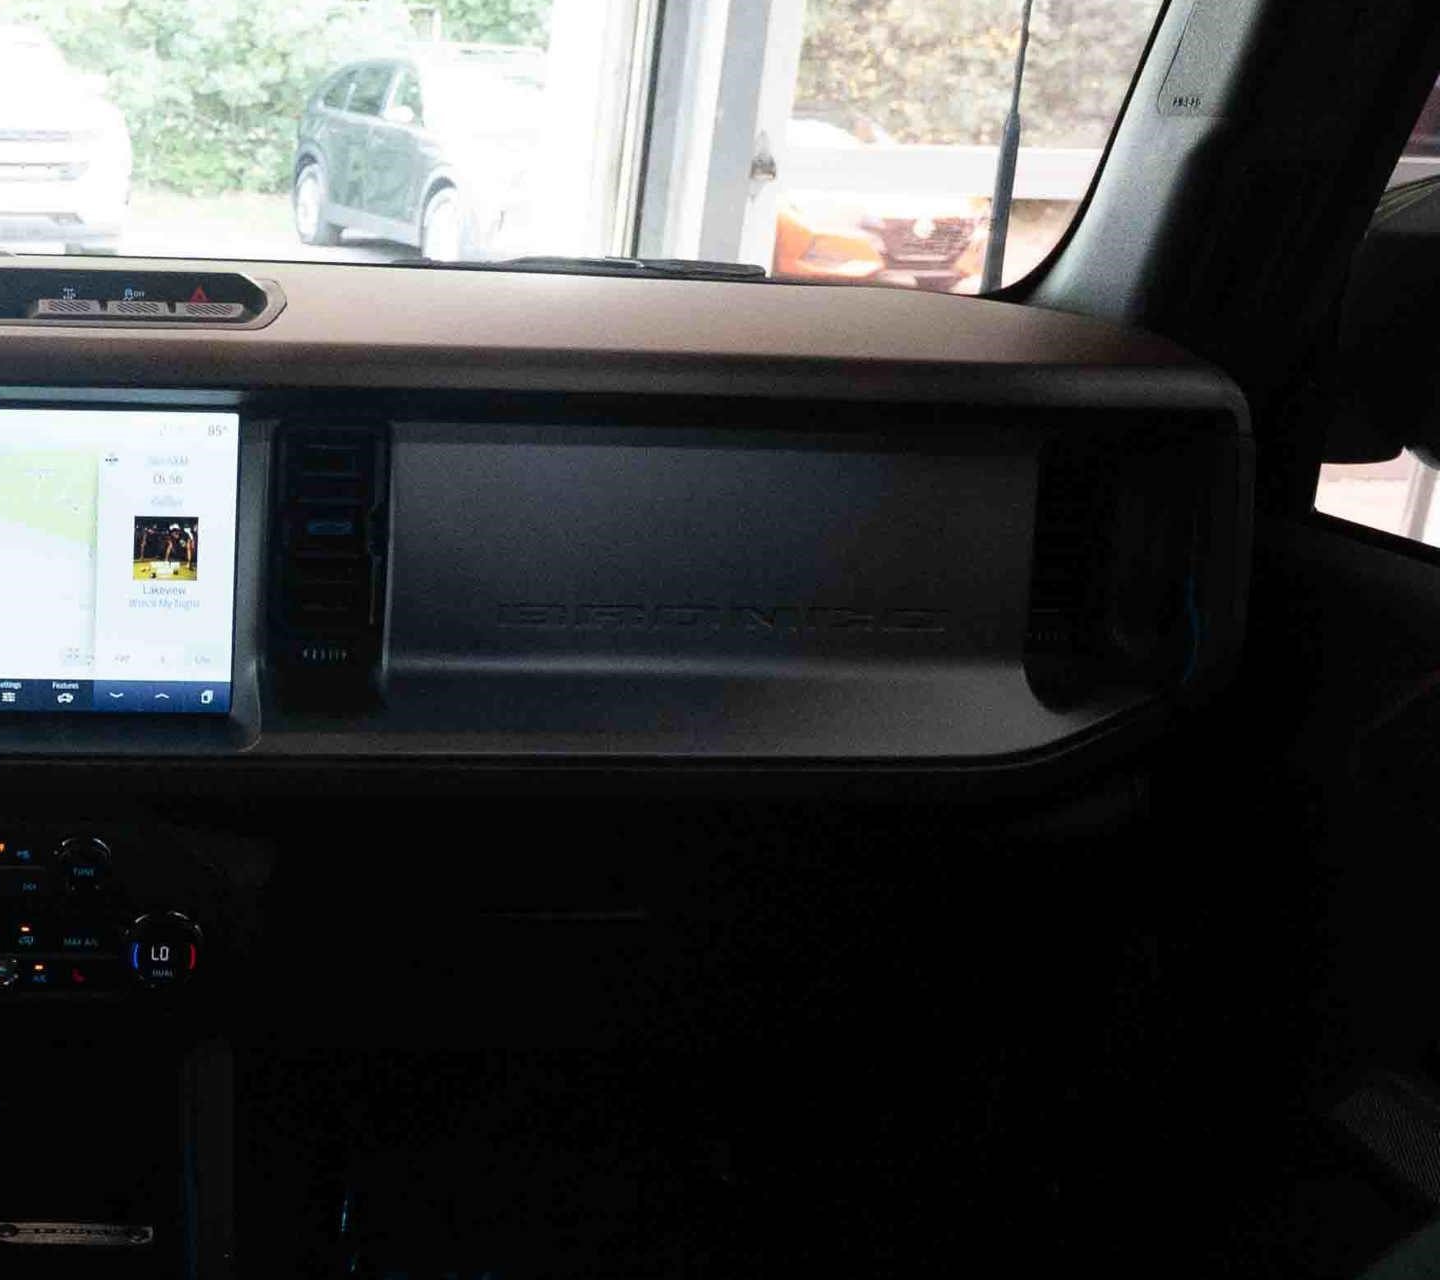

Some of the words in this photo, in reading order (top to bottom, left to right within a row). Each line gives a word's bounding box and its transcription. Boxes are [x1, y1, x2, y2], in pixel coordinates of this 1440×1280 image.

[495, 603, 951, 634] BRONCO
[51, 681, 80, 690] Features
[150, 945, 170, 963] LO
